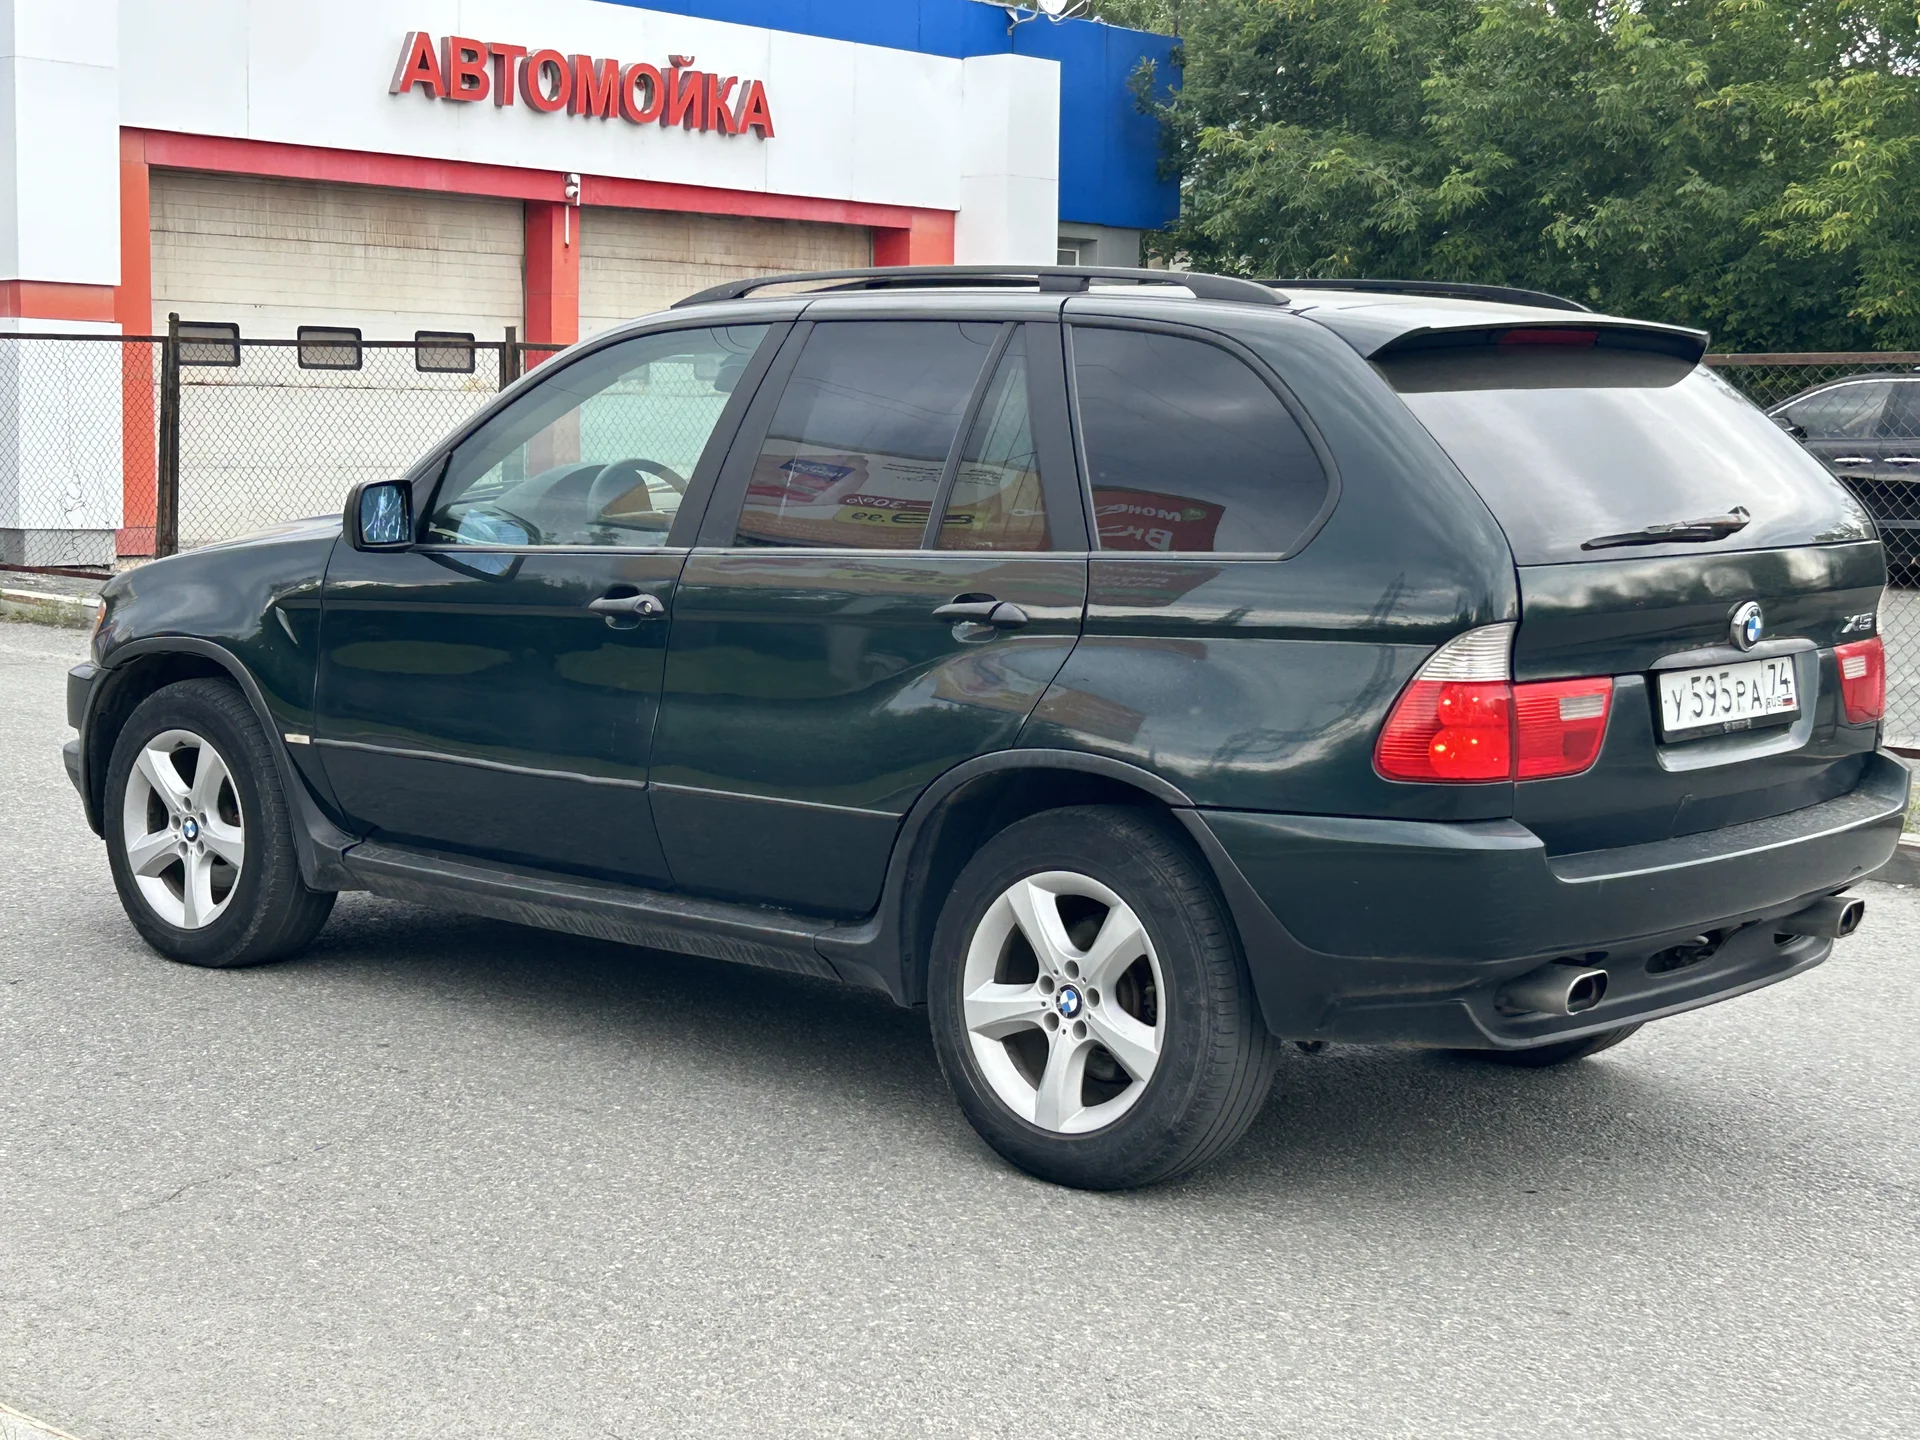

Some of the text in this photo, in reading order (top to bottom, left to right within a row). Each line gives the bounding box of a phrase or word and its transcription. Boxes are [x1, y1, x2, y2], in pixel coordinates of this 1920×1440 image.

[389, 31, 775, 139] АВТОМОЙКА
[1841, 612, 1873, 634] X5
[1766, 695, 1782, 709] RUS
